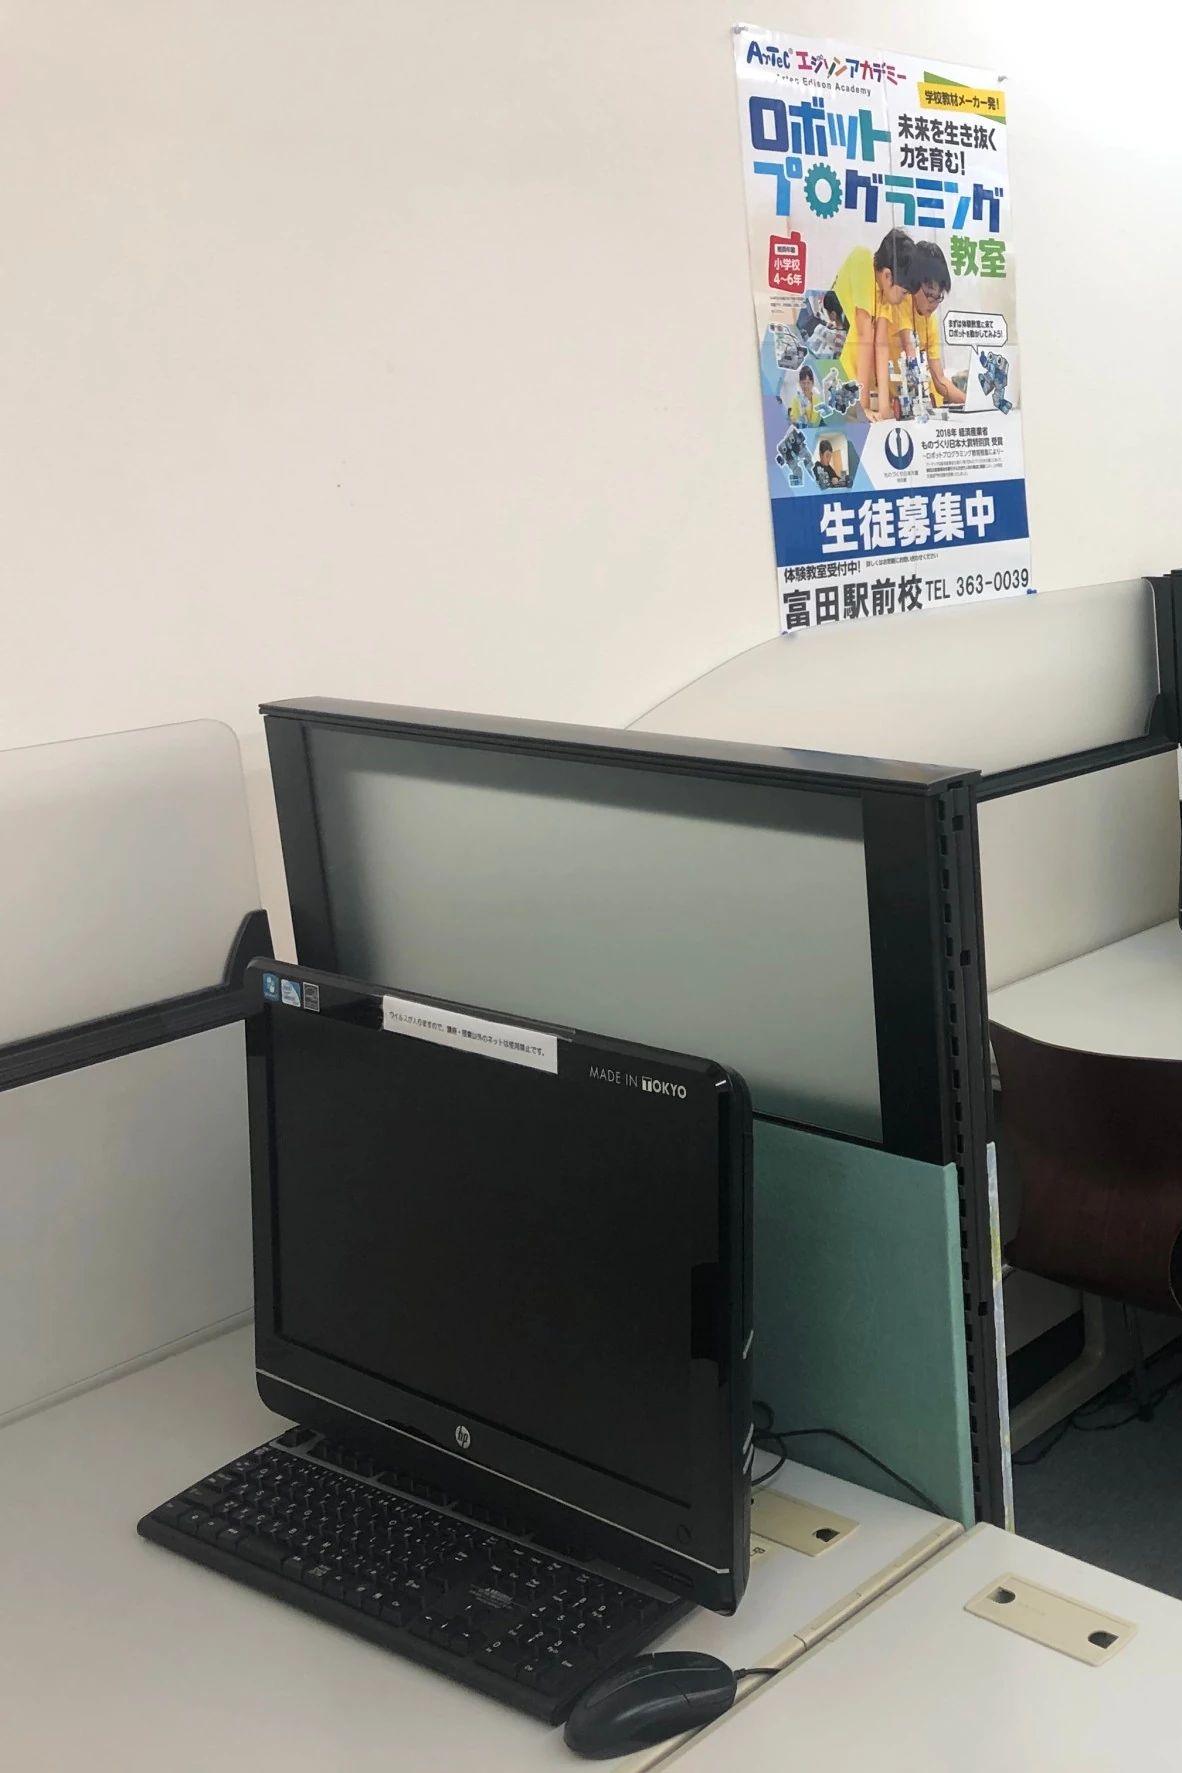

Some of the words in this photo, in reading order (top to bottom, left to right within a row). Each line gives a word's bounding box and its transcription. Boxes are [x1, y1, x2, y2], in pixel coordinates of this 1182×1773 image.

[835, 82, 871, 96] Academy
[749, 96, 892, 162] ロボット
[898, 113, 998, 151] 未来を生き抜く
[899, 144, 965, 176] 力を育む!
[753, 156, 1004, 233] プログラミング
[774, 257, 801, 272] 小学校
[950, 234, 1007, 278] 教室
[820, 489, 996, 555] 生徒募集中
[783, 560, 861, 584] 体験教室受付中!
[783, 574, 923, 631] 富田駅前校
[925, 578, 951, 602] TEL
[956, 567, 1030, 599] 363-0039
[589, 1065, 622, 1086] MADE
[624, 1073, 638, 1088] IN
[641, 1075, 687, 1100] TOKYO
[455, 1425, 471, 1449] hp
